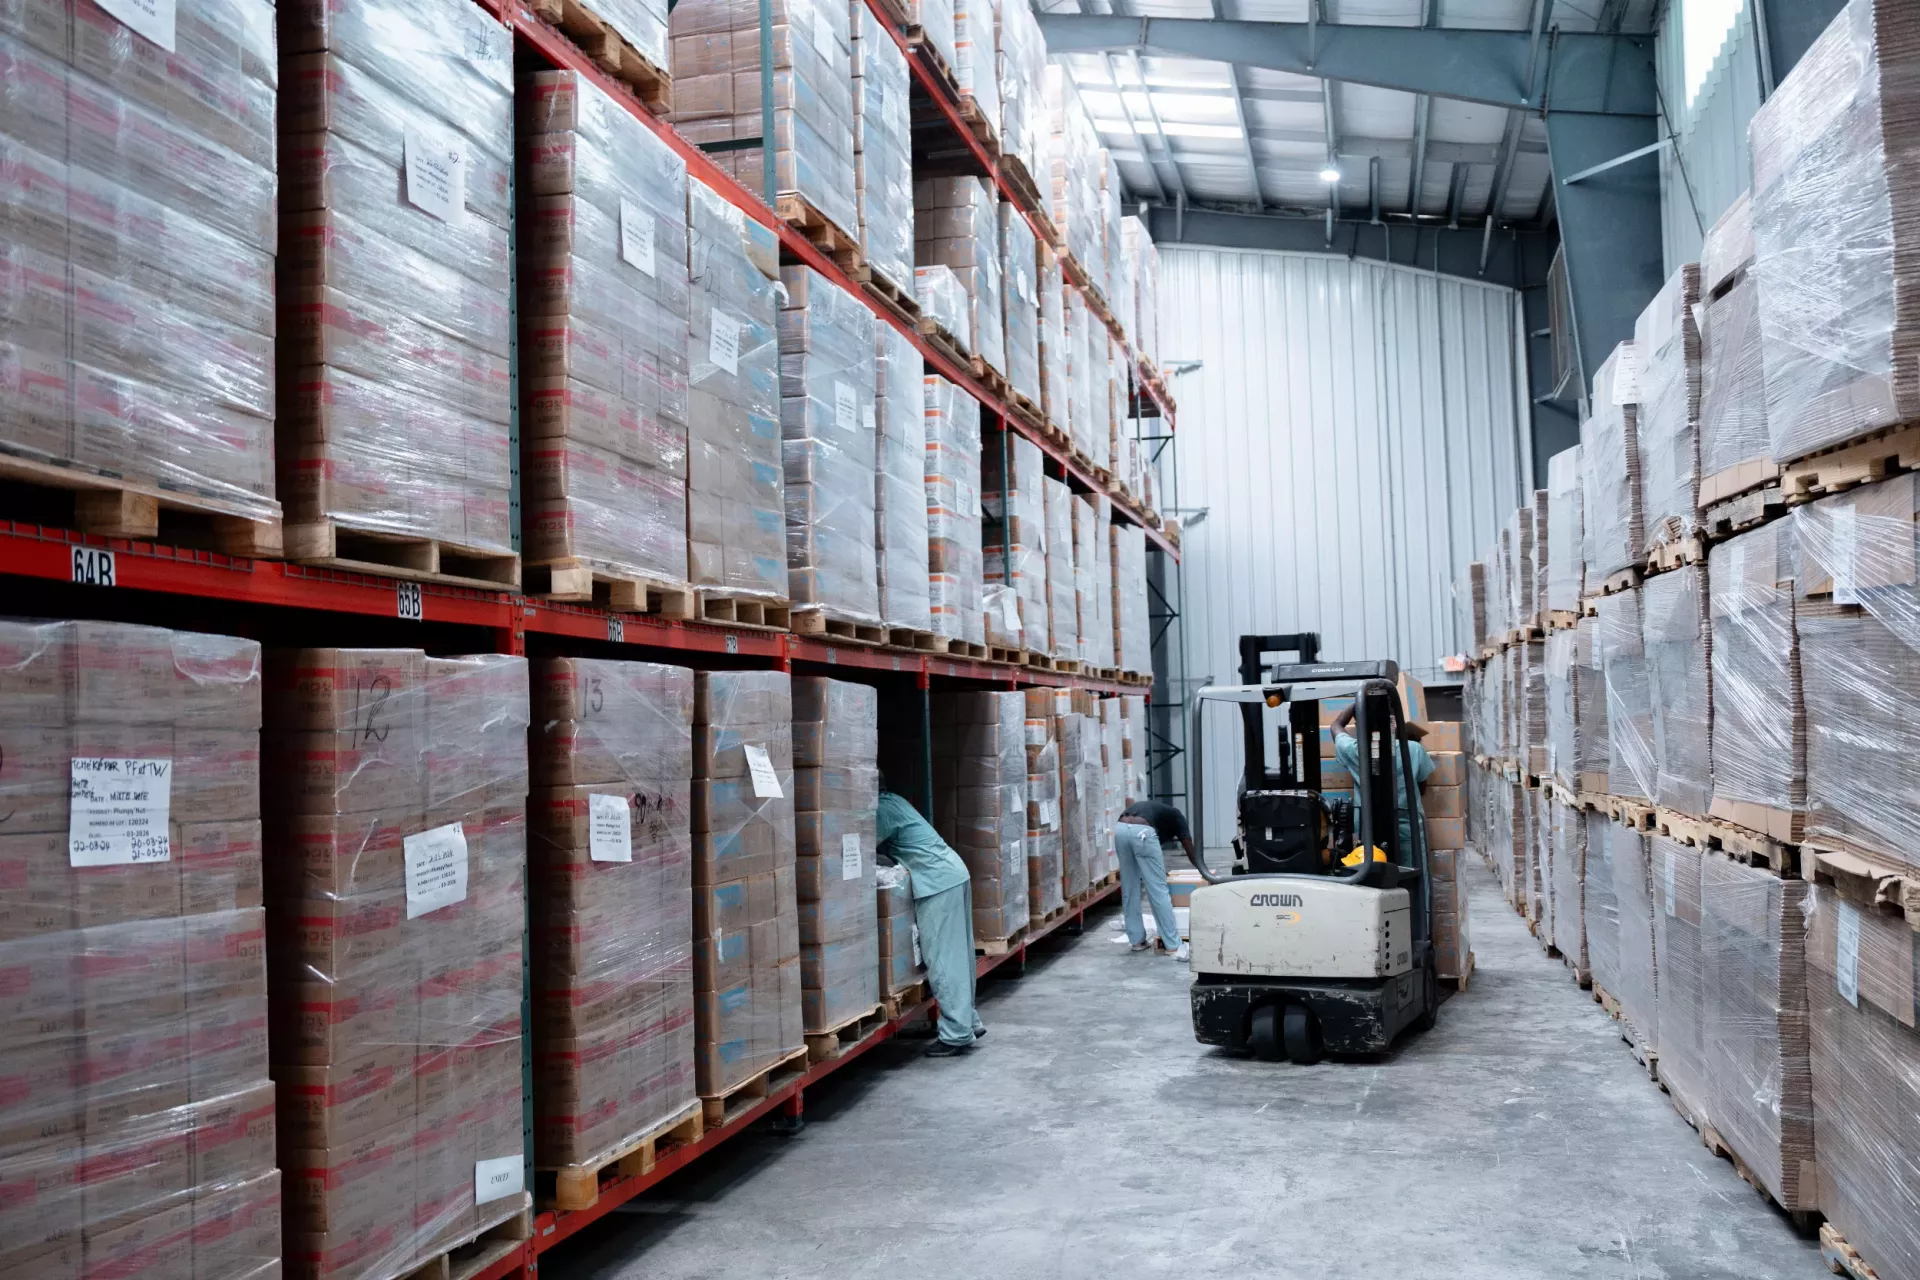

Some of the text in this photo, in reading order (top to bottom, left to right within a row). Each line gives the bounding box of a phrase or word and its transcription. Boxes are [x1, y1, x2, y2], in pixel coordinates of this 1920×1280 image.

[74, 549, 113, 584] 64B
[399, 583, 421, 617] 65B
[352, 674, 391, 750] 12
[583, 677, 603, 718] 13
[1250, 893, 1303, 907] CROWN
